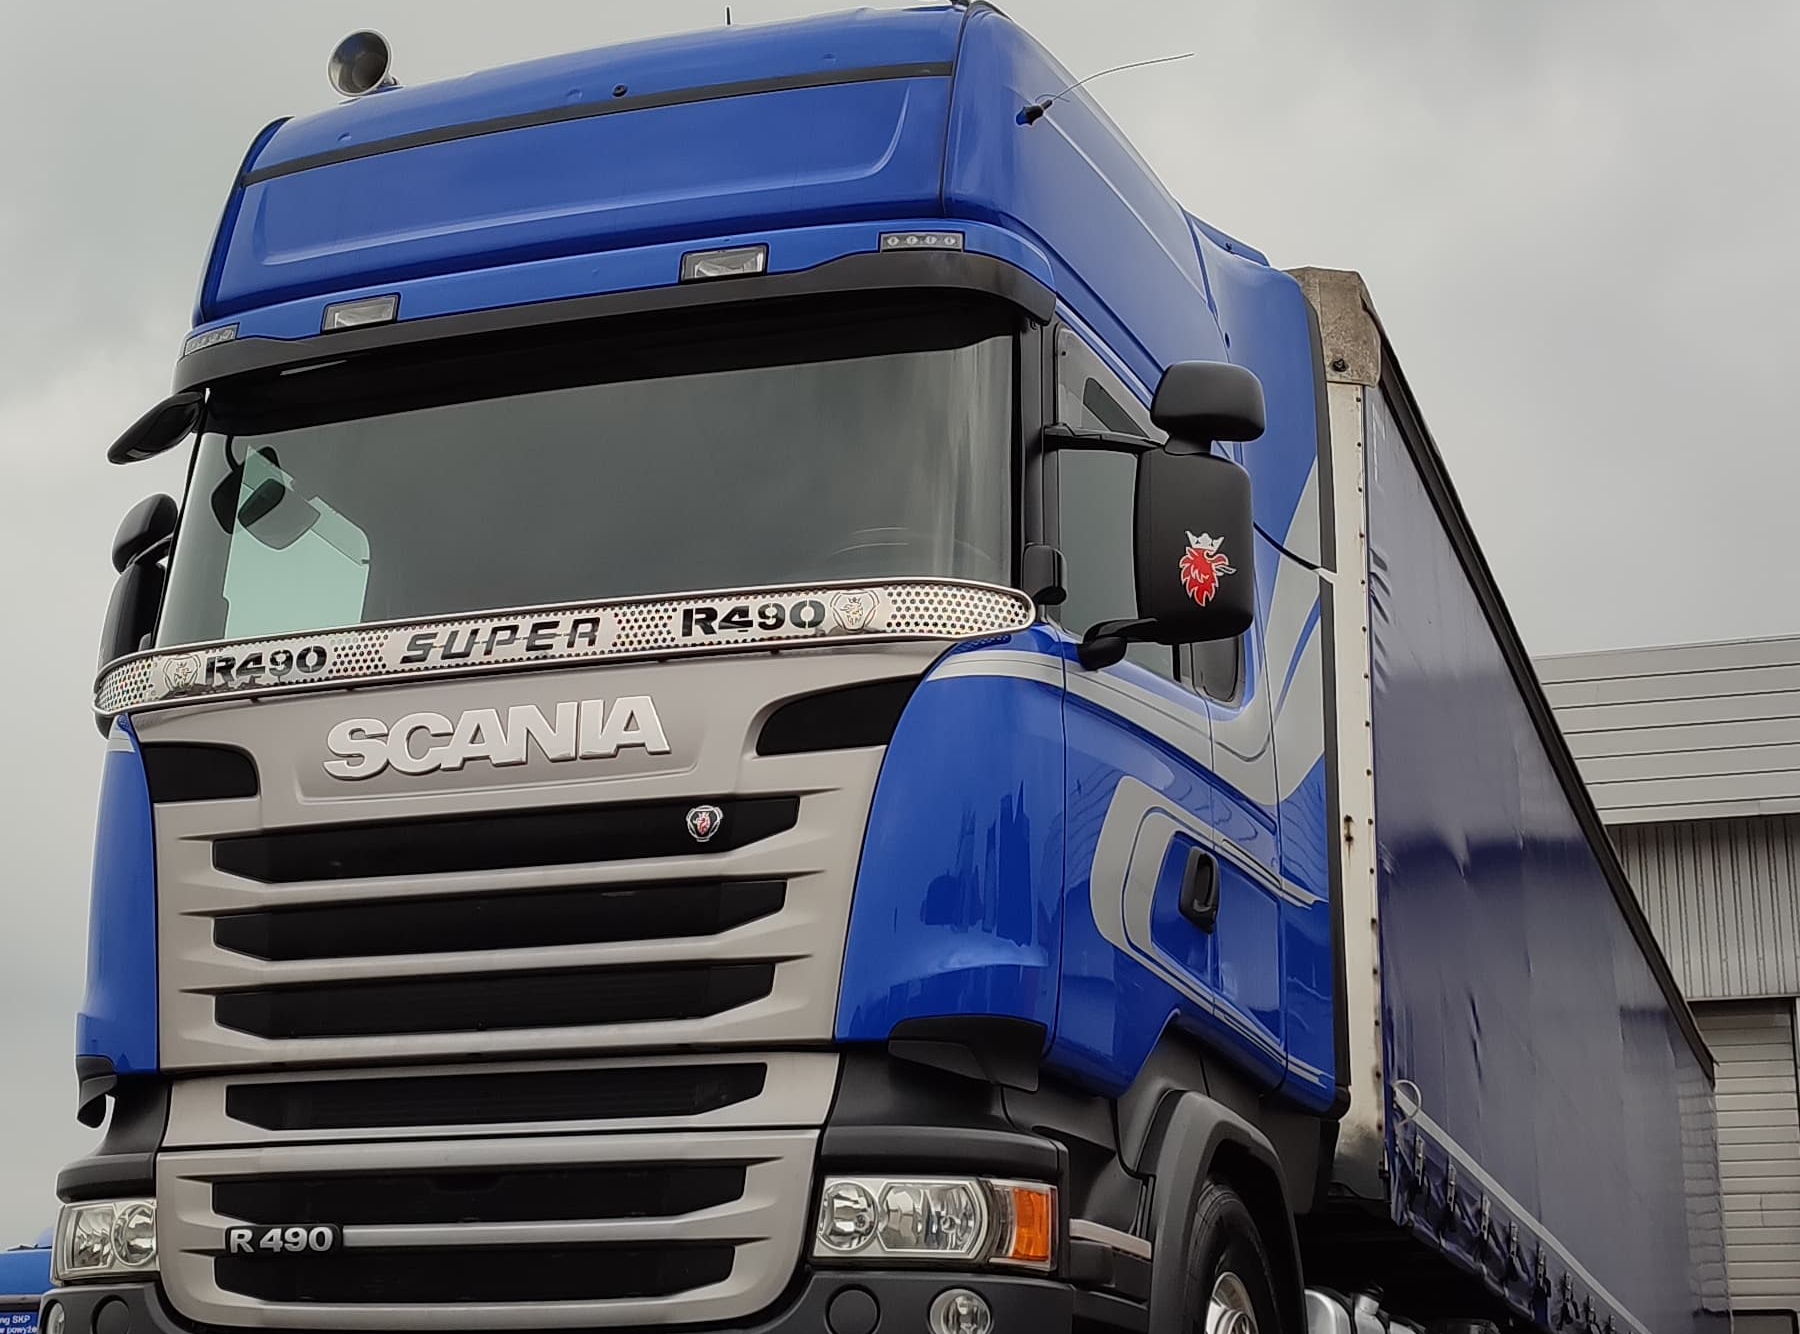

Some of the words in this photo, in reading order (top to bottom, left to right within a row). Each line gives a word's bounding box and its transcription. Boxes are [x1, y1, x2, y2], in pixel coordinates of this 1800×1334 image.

[205, 645, 328, 686] R490
[400, 616, 600, 664] SUPER
[682, 599, 826, 638] R490
[323, 695, 672, 781] SCANIA
[230, 1228, 255, 1253] R
[260, 1226, 334, 1253] 490
